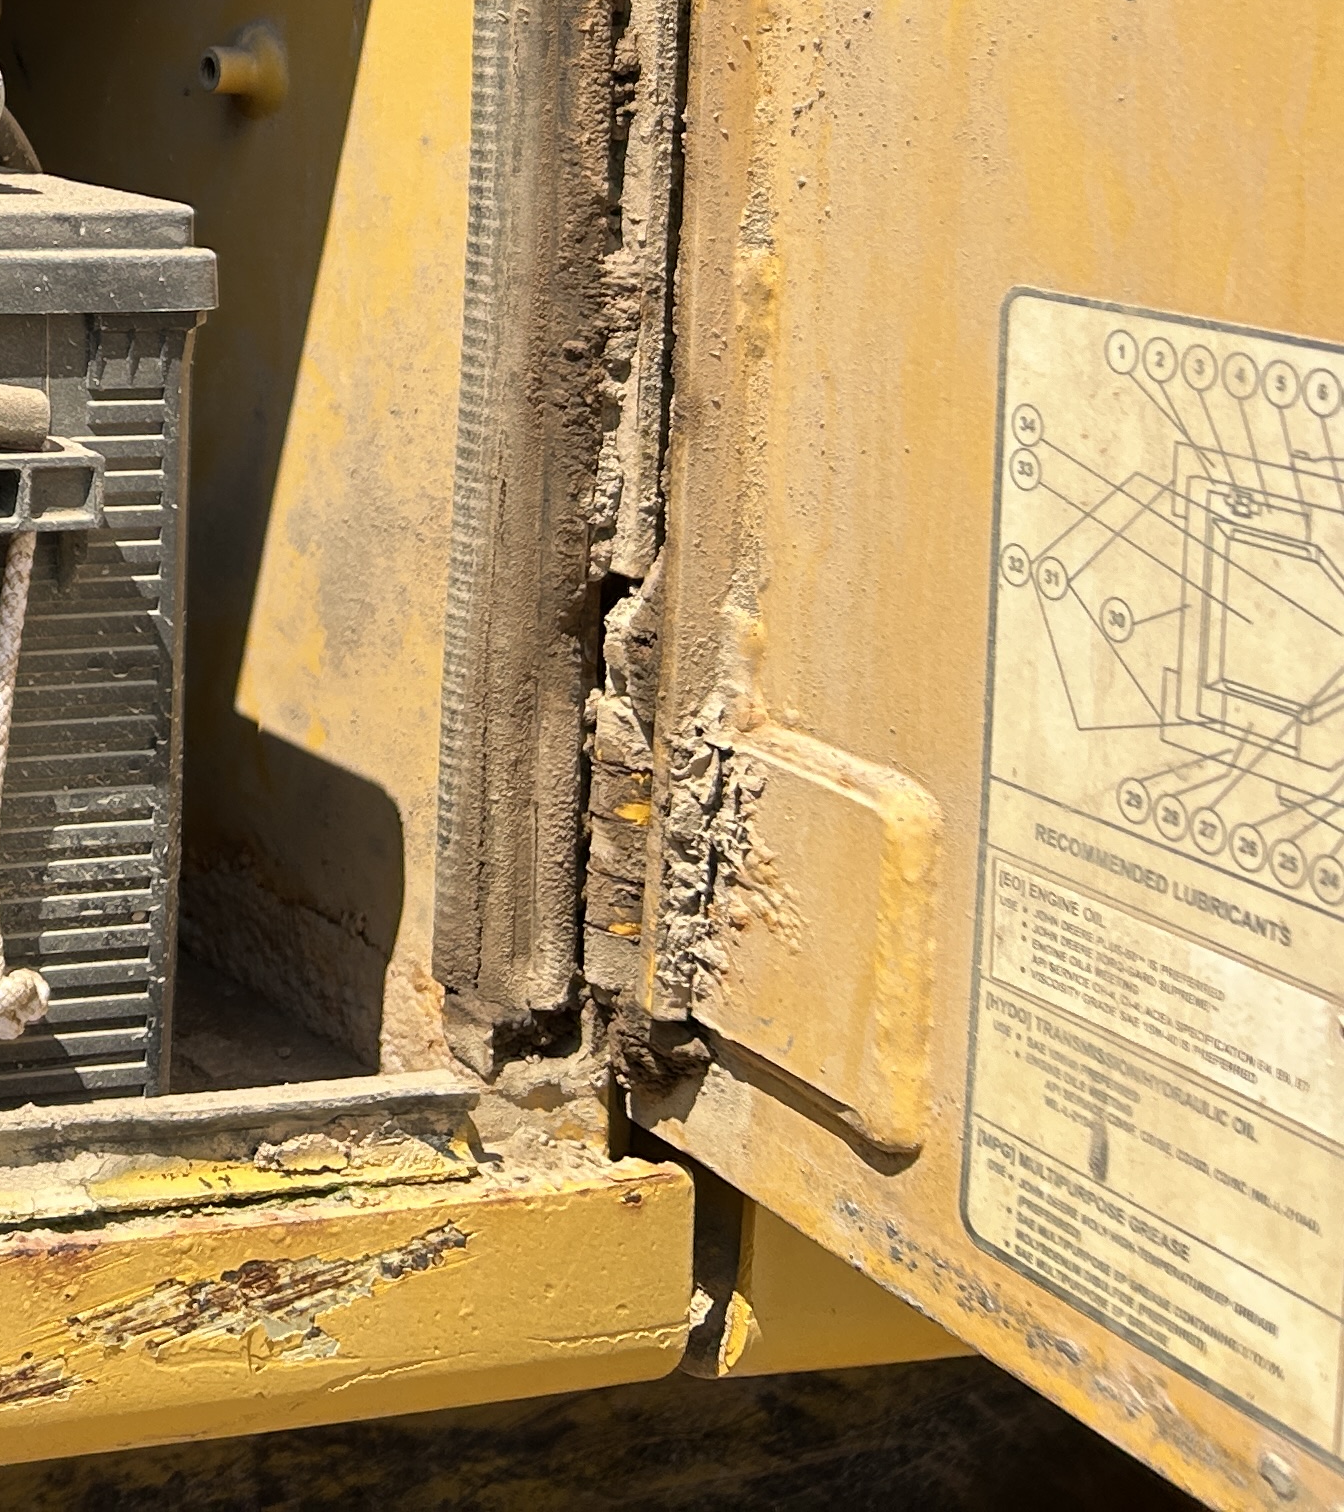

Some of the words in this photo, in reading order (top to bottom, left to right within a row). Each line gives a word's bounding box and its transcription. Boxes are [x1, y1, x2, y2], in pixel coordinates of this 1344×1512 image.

[1119, 344, 1126, 359] 1
[1155, 351, 1164, 368] 2
[1194, 359, 1205, 375] 3
[1019, 416, 1036, 433] 34
[1008, 555, 1024, 575] 32
[1044, 568, 1059, 587] 31
[1034, 822, 1169, 895] RECOMMENDED
[1173, 880, 1292, 947] LUBRICANTS
[1029, 882, 1079, 918] ENGINE
[1083, 905, 1107, 929] OIL
[1232, 1113, 1257, 1143] OIL
[1019, 1150, 1124, 1227] MULTIPURPOSE
[1128, 1211, 1190, 1264] GREASE
